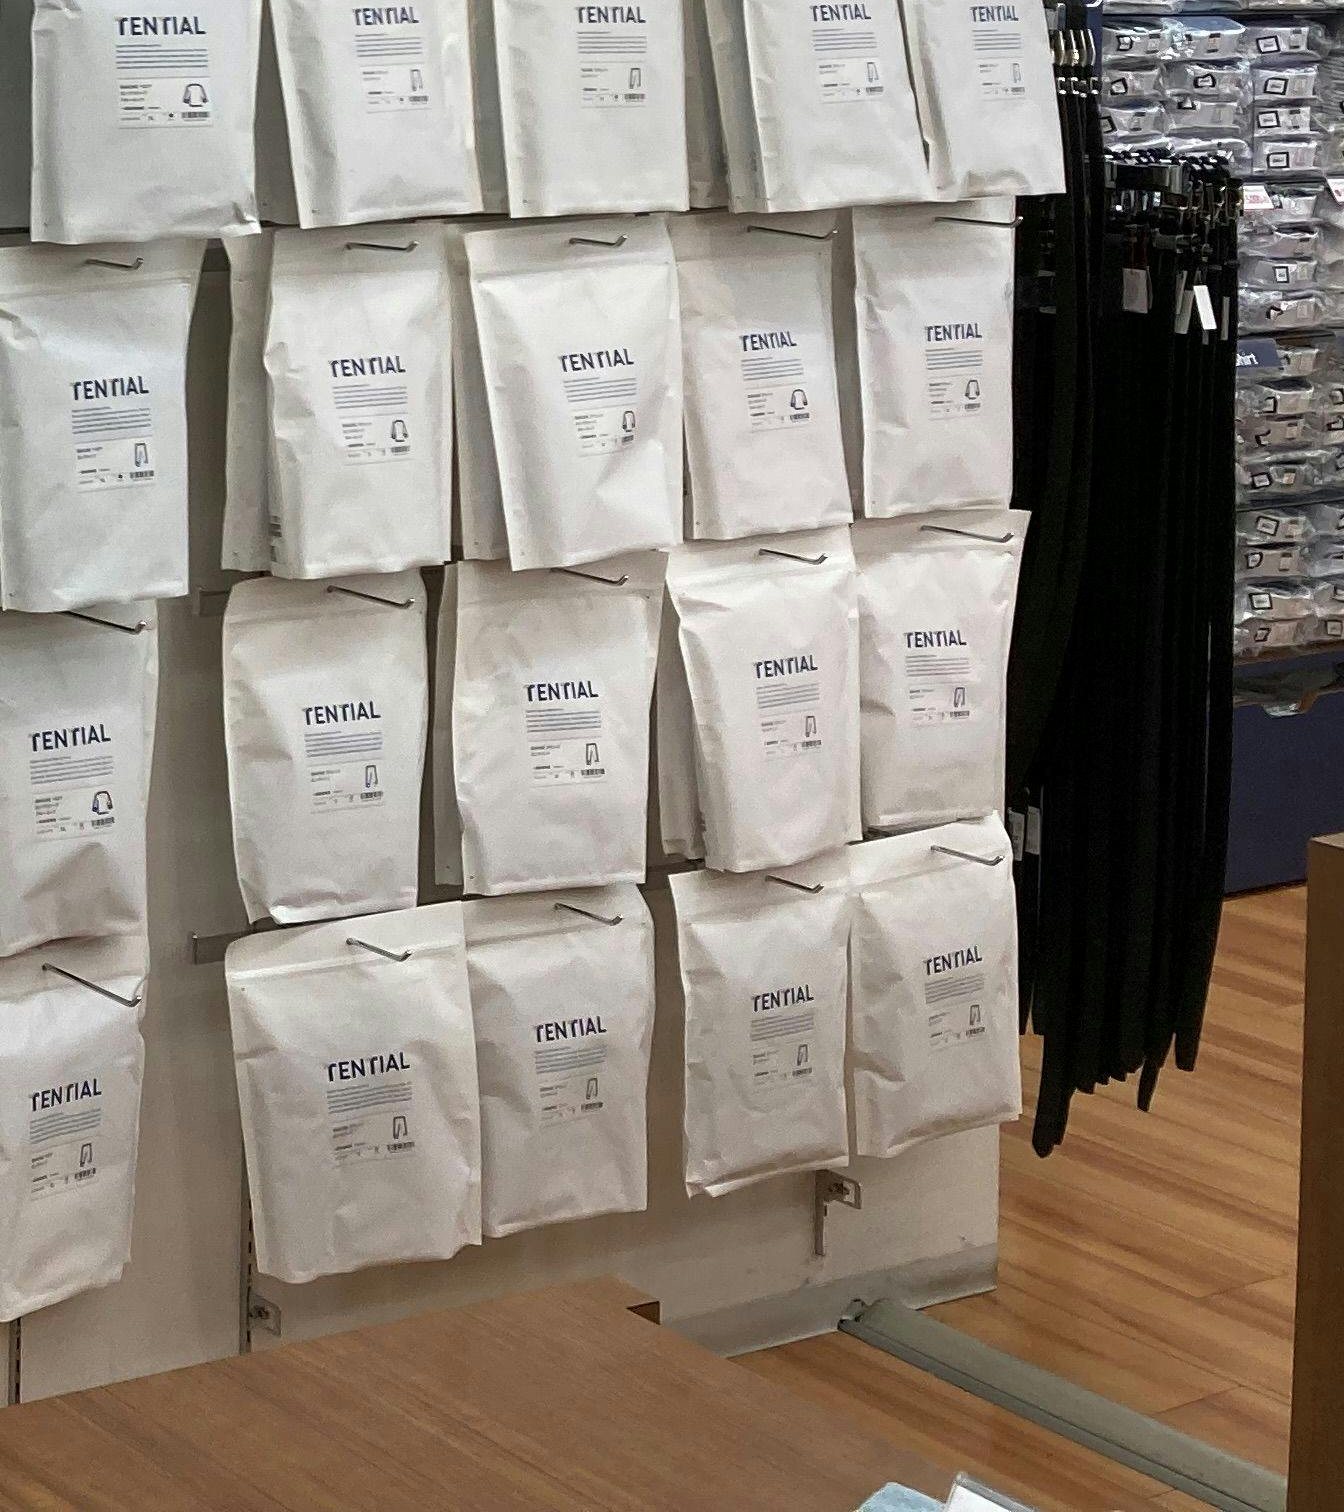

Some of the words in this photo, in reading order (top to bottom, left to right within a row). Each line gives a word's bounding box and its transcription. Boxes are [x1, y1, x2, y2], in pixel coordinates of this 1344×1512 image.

[352, 6, 419, 26] TENTIAL
[575, 5, 646, 25] TENTIAL
[810, 3, 872, 22] TENTIAL
[970, 5, 1019, 23] TENTIAL
[115, 16, 206, 36] TENTIAL
[739, 331, 798, 352] TENTIAL
[924, 322, 982, 342] TENTIAL
[327, 356, 405, 377] TENTIAL
[557, 348, 634, 374] TENTIAL
[70, 376, 148, 400] TENTIAL
[904, 629, 967, 649] TENTIAL
[753, 654, 818, 679] TENTIAL
[524, 681, 598, 701] TENTIAL
[302, 702, 380, 725] TENTIAL
[28, 724, 111, 751] TENTIAL
[922, 945, 983, 976] TENTIAL
[751, 984, 814, 1012] TENTIAL
[533, 1016, 607, 1042] TENTIAL
[324, 1052, 410, 1081] TENTIAL
[28, 1079, 101, 1111] TENTIAL
